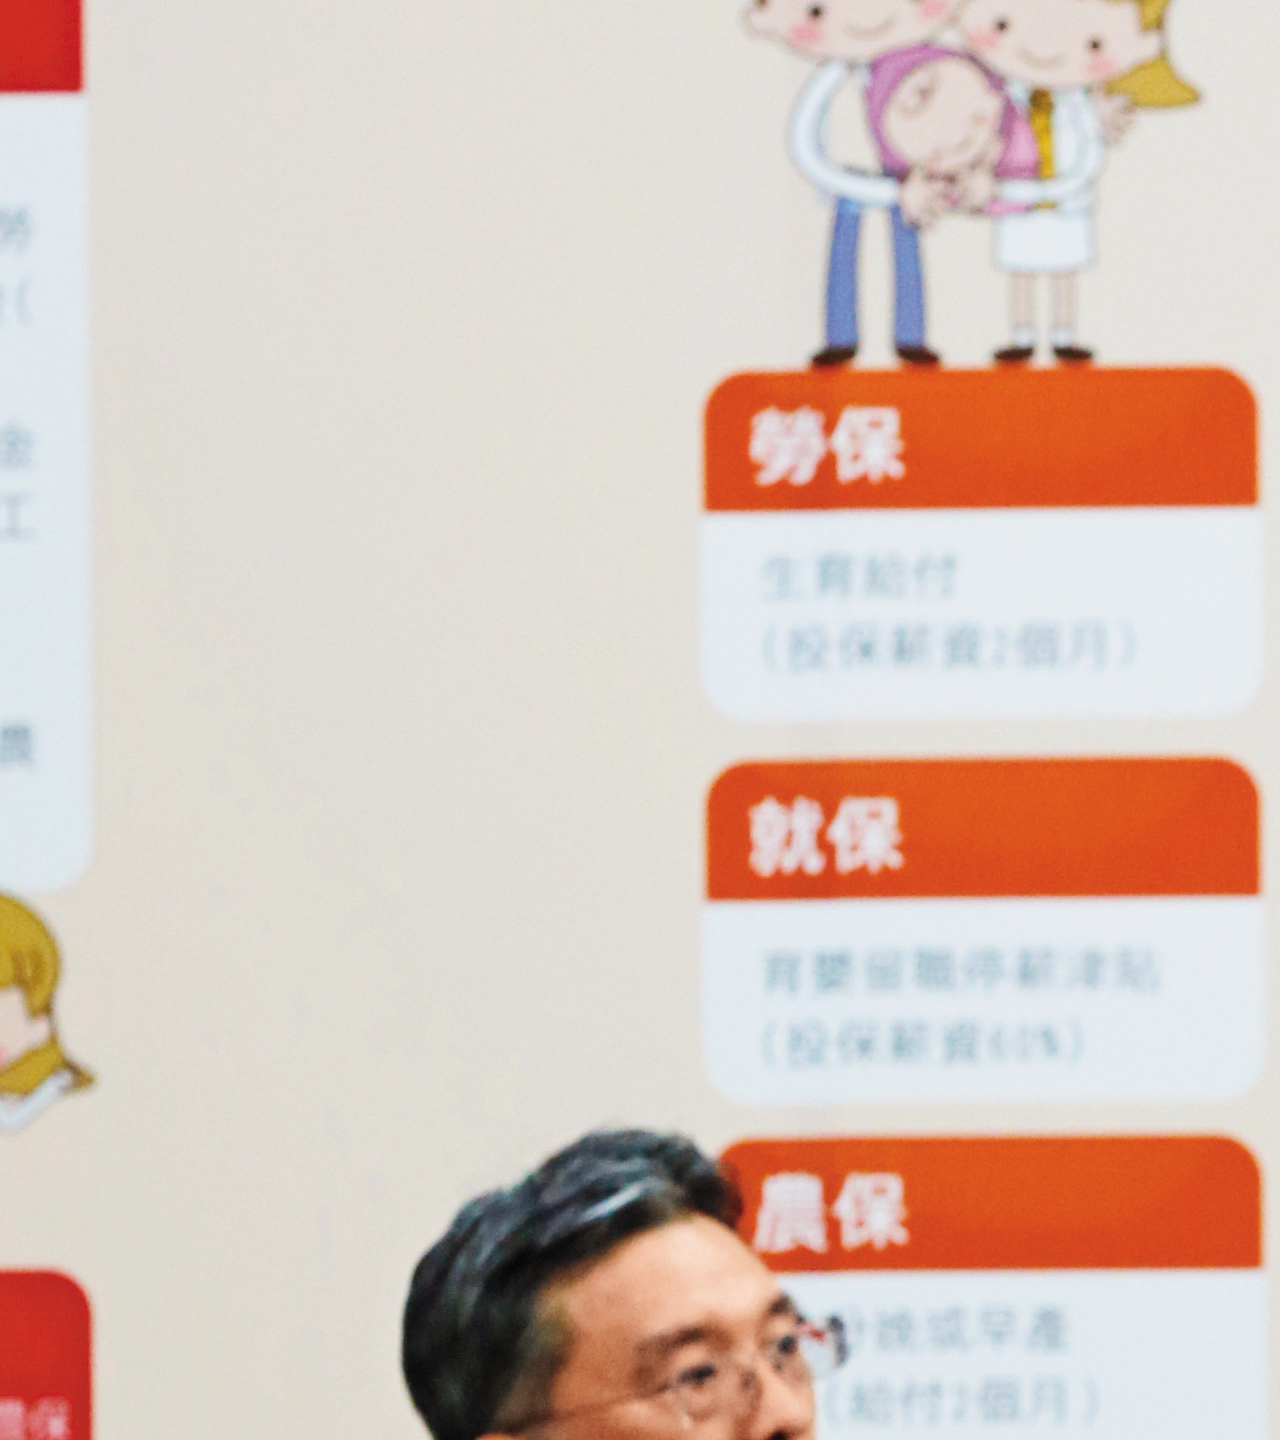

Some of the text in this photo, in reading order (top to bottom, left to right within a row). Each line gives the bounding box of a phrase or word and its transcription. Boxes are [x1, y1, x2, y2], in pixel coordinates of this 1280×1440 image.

[749, 406, 906, 486] 勞保
[748, 796, 905, 878] 就保
[754, 1172, 909, 1253] 農保
